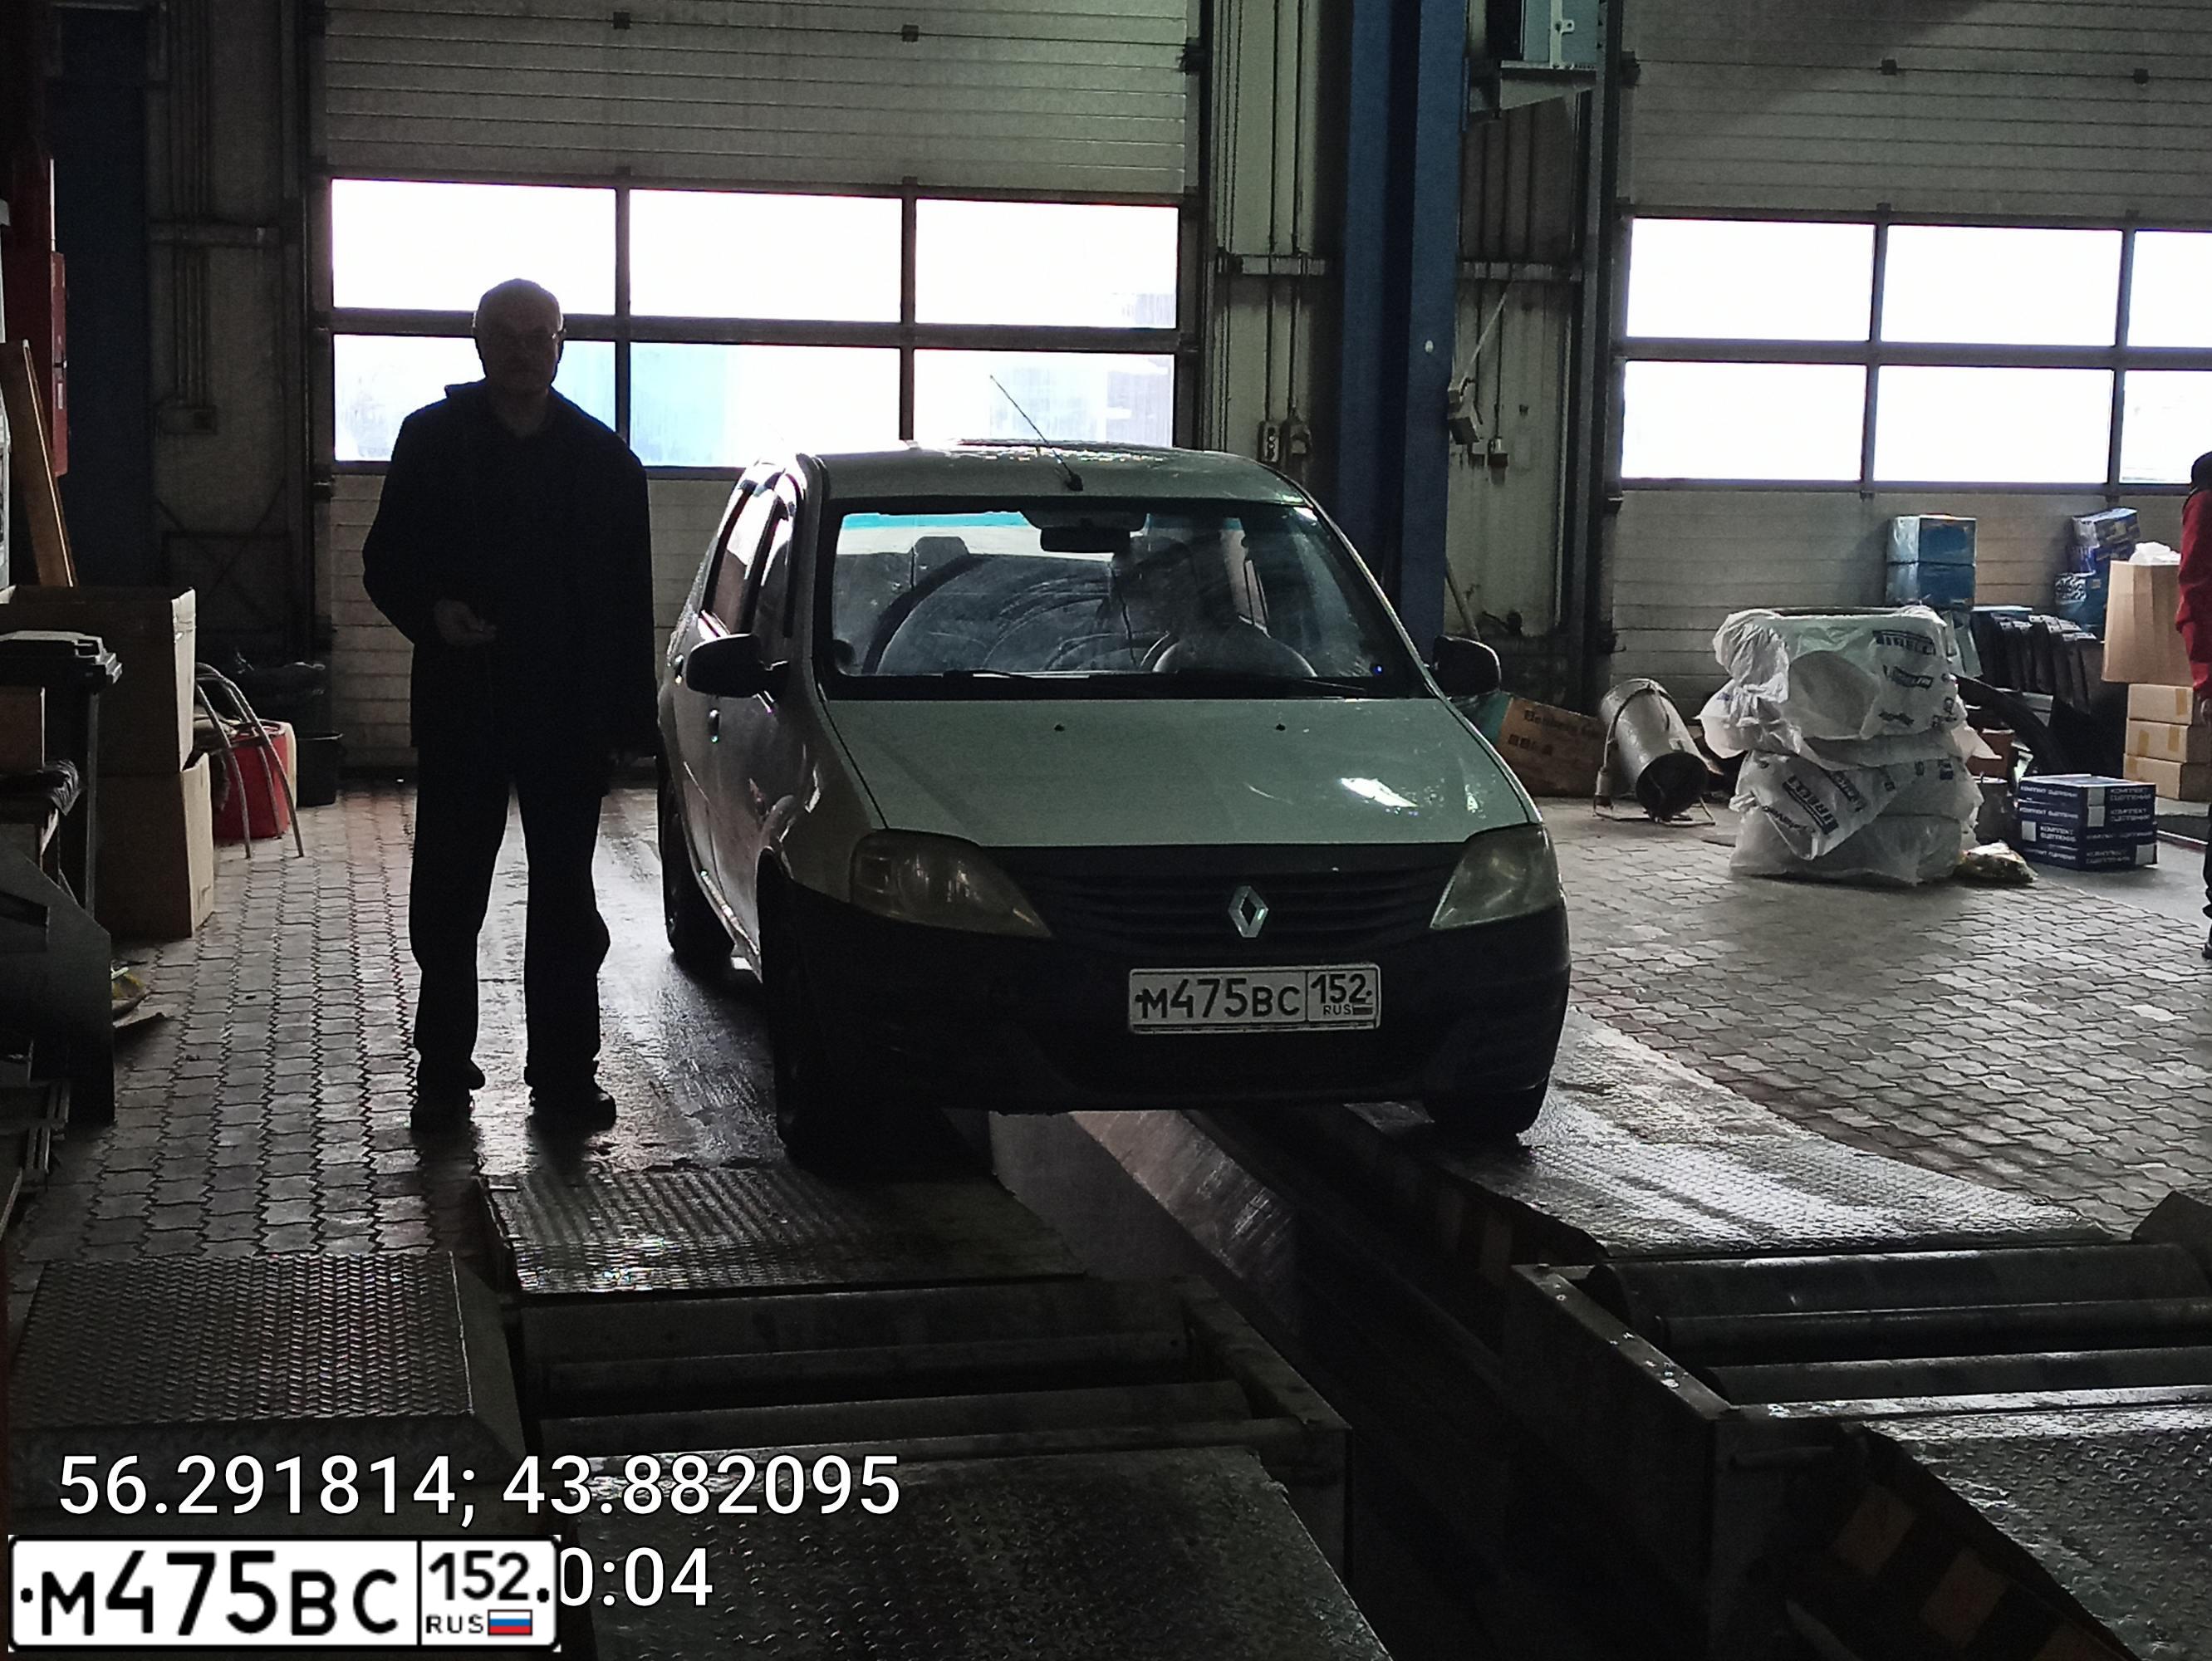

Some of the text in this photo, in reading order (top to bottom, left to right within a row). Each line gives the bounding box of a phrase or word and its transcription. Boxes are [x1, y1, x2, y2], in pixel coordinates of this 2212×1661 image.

[1141, 973, 1367, 1019] М475ВС 152
[1323, 1004, 1351, 1016] RUS
